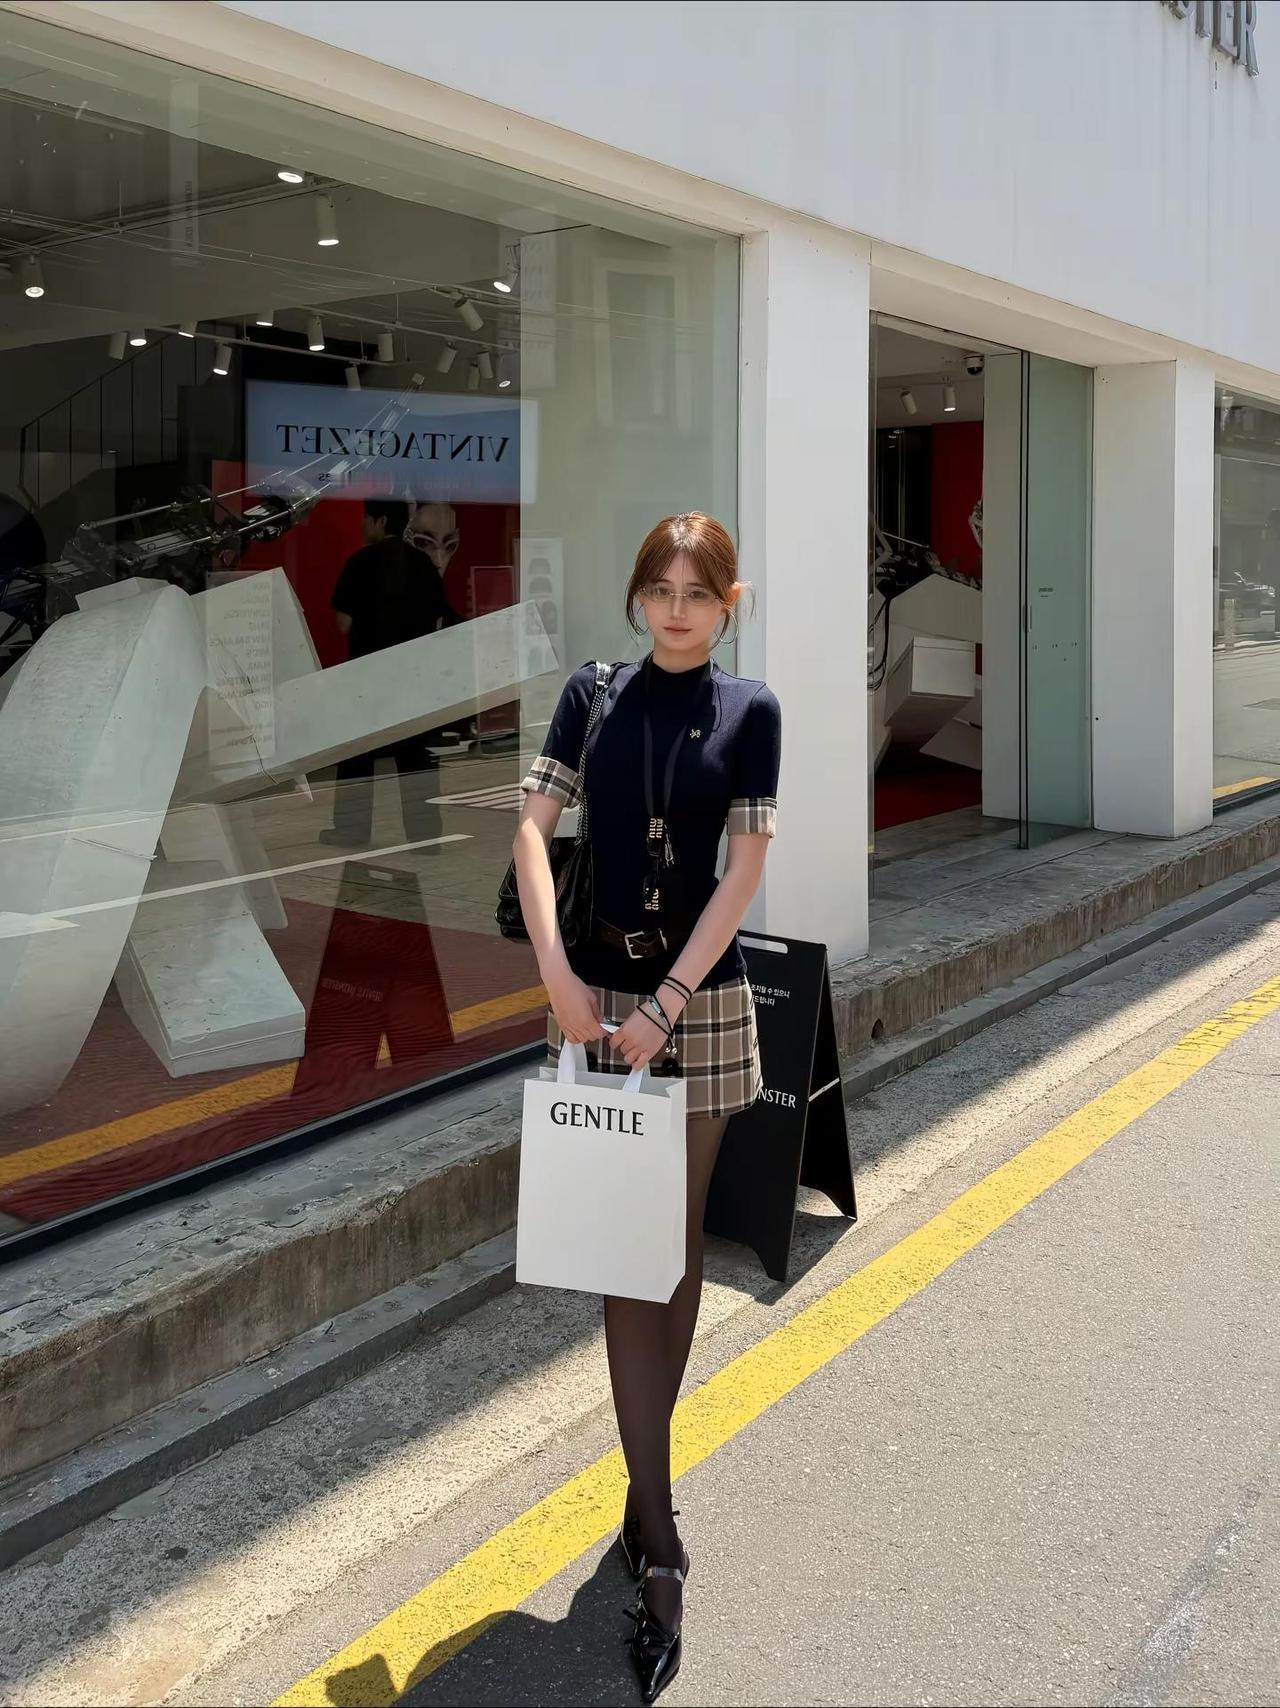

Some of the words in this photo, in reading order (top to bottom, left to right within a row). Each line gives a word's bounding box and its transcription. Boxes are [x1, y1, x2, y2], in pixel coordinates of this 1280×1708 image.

[767, 987, 773, 995] 수
[773, 988, 790, 999] 있으니
[752, 994, 776, 1006] 드립니다
[549, 1101, 644, 1136] GENTLE
